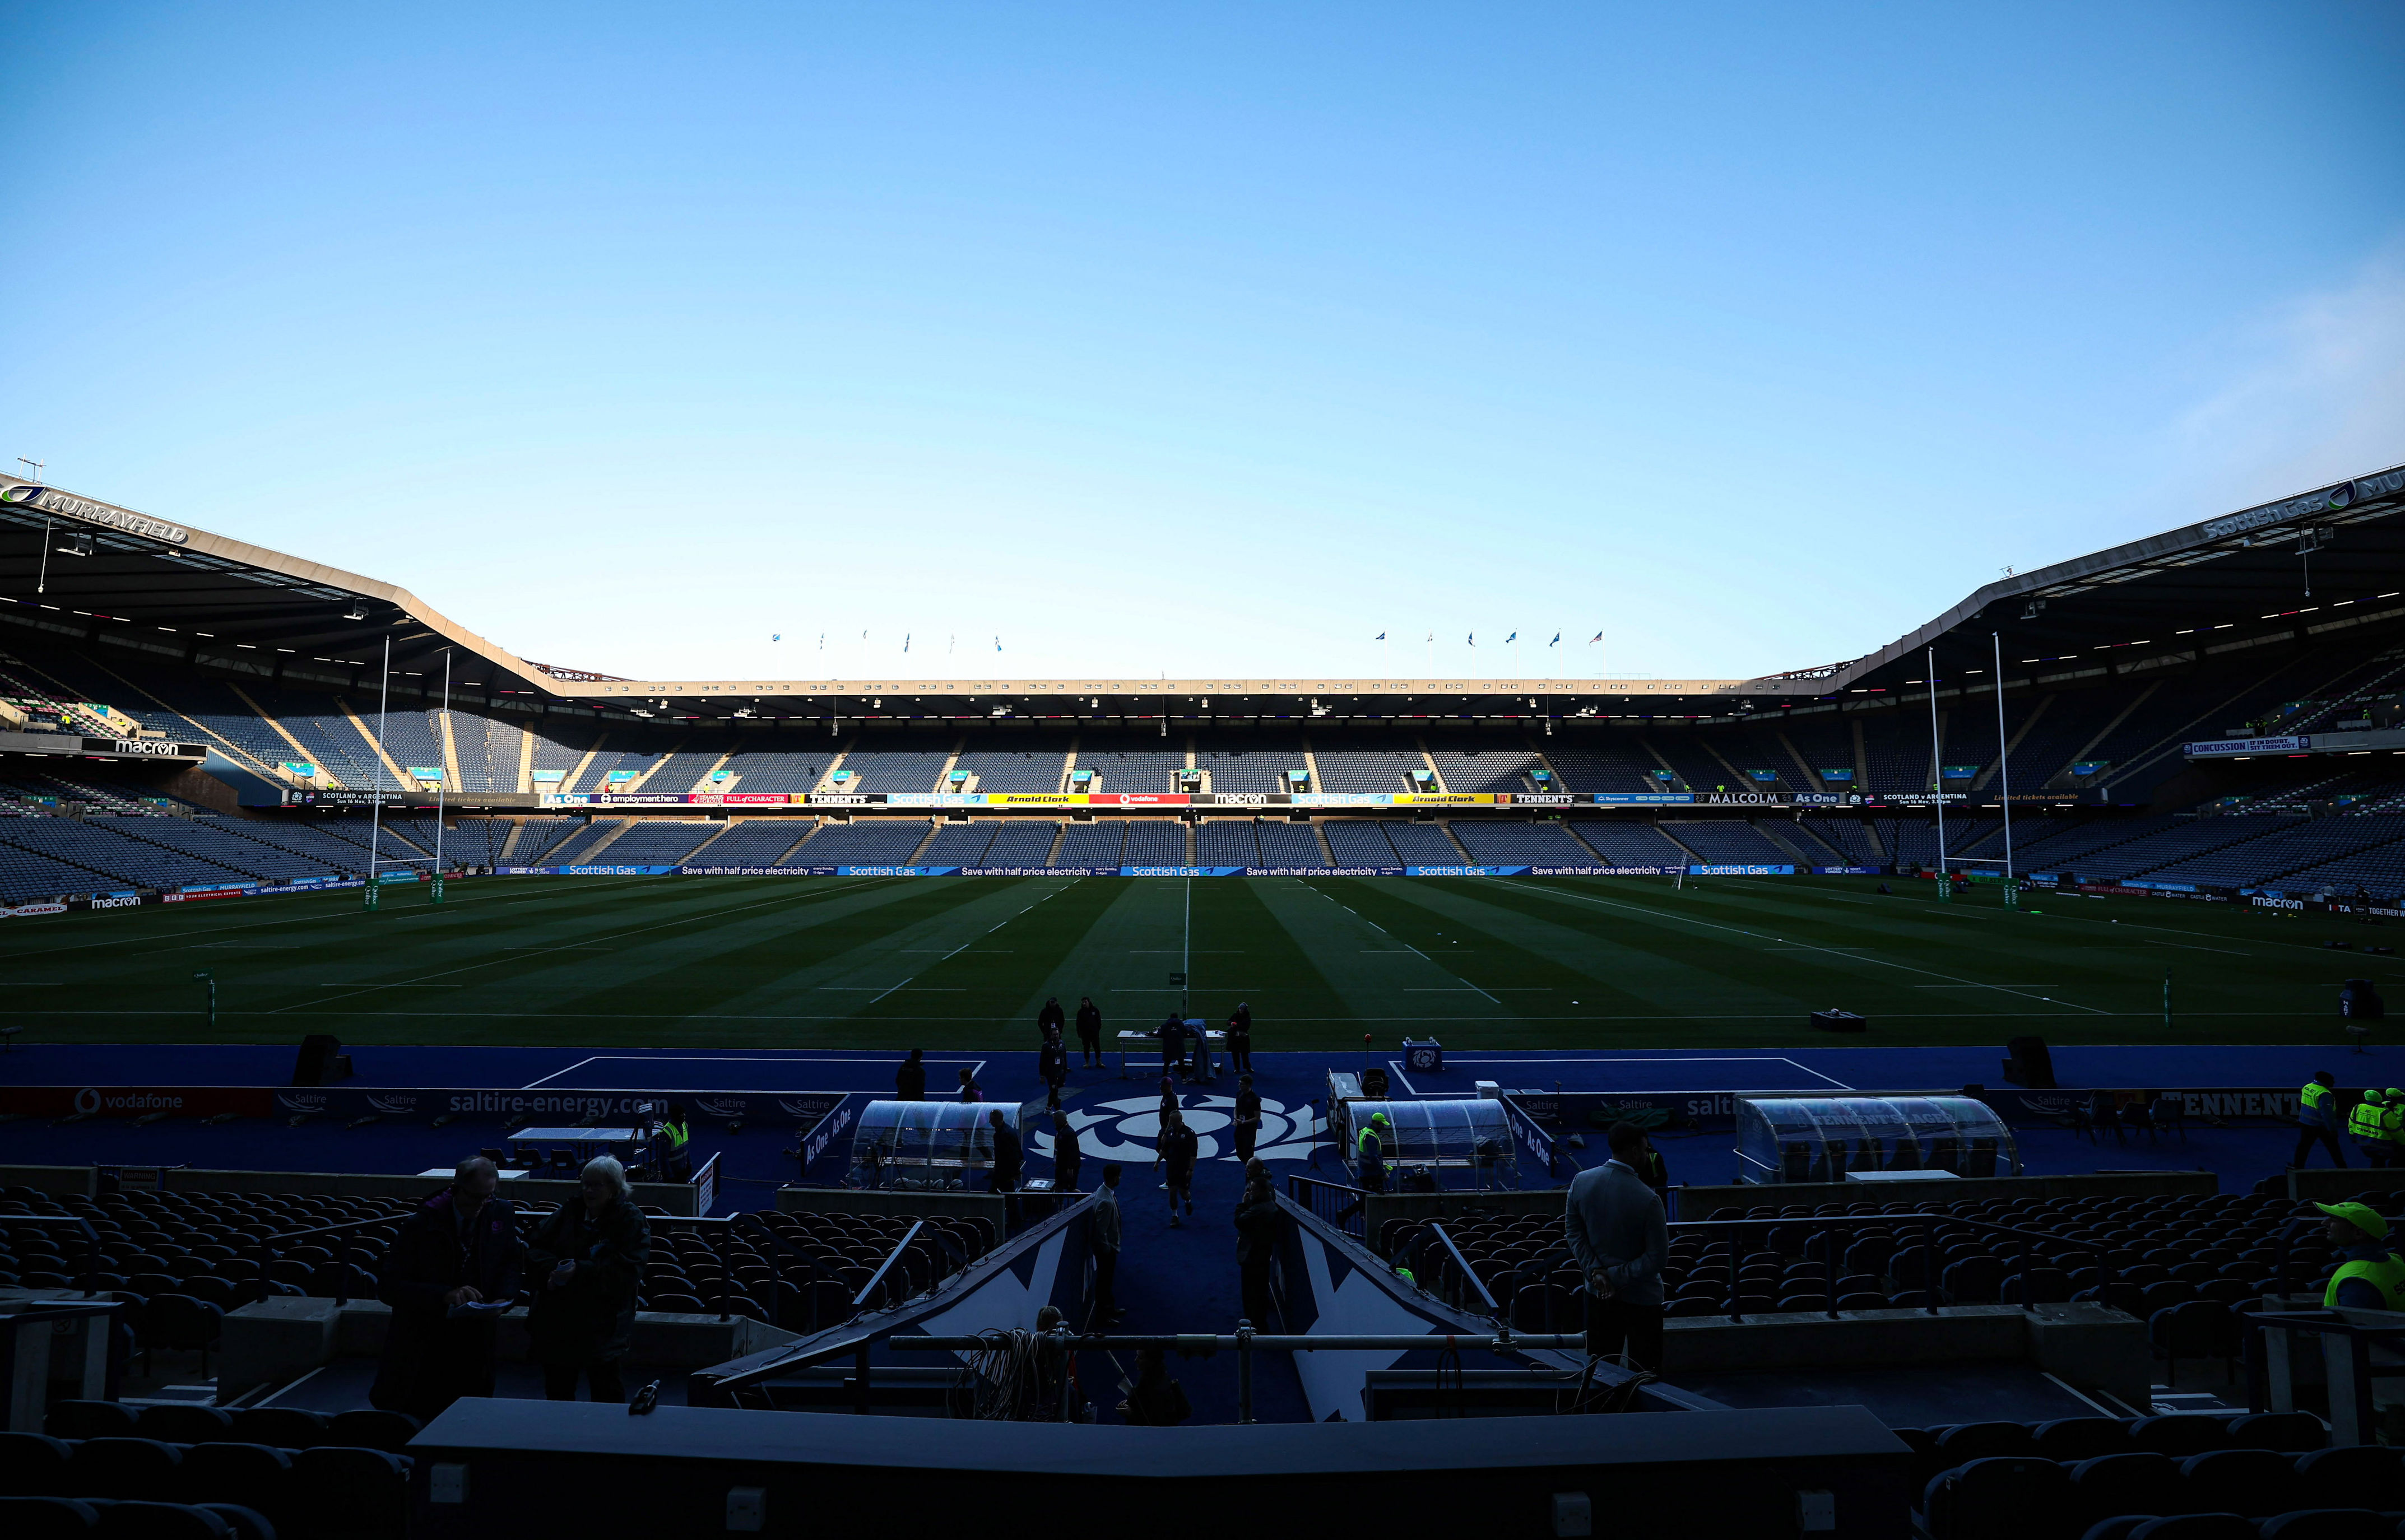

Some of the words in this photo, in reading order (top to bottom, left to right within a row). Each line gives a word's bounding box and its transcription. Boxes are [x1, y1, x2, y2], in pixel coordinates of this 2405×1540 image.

[40, 491, 187, 543] MURRAYFIELD
[2203, 508, 2280, 538] Scottish
[2282, 497, 2323, 518] Gas
[115, 740, 178, 756] macron
[2194, 742, 2245, 752] CONCUSSION
[546, 795, 562, 803] As
[564, 795, 588, 803] One
[893, 794, 941, 804] Scottish
[943, 794, 964, 804] Gas
[1215, 794, 1267, 804] macron
[1298, 794, 1346, 804] Scottish
[1348, 794, 1369, 804] Gas
[1709, 793, 1779, 803] MALCOLM
[1795, 794, 1811, 803] As
[1812, 794, 1838, 803] One
[570, 866, 614, 874] Scottish
[616, 866, 637, 874] Gas
[682, 866, 703, 874] Save
[704, 866, 723, 874] with
[725, 866, 741, 874] half
[742, 866, 763, 876] price
[765, 866, 809, 876] electricity
[849, 867, 893, 876] Scottish
[895, 867, 916, 876] Gas
[962, 867, 982, 876] Save
[985, 867, 1004, 876] with
[1005, 867, 1022, 876] half
[1023, 867, 1044, 877] price
[1047, 867, 1091, 877] electricity
[1132, 867, 1177, 876] Scottish
[1179, 867, 1199, 876] Gas
[1246, 867, 1268, 876] Save
[1269, 867, 1288, 876] with
[1290, 867, 1306, 876] half
[1308, 867, 1329, 877] price
[1332, 867, 1377, 877] electricity
[1418, 867, 1463, 876] Scottish
[1465, 867, 1485, 876] Gas
[1532, 866, 1553, 874] Save
[1554, 866, 1574, 874] with
[1575, 866, 1591, 874] half
[1593, 866, 1615, 876] price
[1617, 866, 1661, 876] electricity
[1701, 866, 1745, 874] Scottish
[1748, 866, 1768, 874] Gas
[261, 884, 308, 893] saltire-energy.com
[2156, 885, 2194, 894] MURRAYFIELD
[91, 896, 141, 909] macron
[2253, 896, 2304, 910] macron
[17, 906, 63, 914] CARAMEL
[2369, 908, 2398, 916] TOGETHER
[105, 1093, 183, 1109] vodafone
[295, 1094, 327, 1104] Saltire
[384, 1095, 416, 1104] Saltire
[713, 1098, 746, 1108] Saltire
[797, 1099, 829, 1109] Saltire
[2038, 1096, 2070, 1105] Saltire
[450, 1091, 668, 1118] saltire-energy.com
[1526, 1101, 1559, 1110] Saltire
[1619, 1100, 1652, 1109] Saltire
[833, 1119, 839, 1138] As
[840, 1109, 851, 1129] One
[1814, 1114, 1903, 1126] TENNENT'S
[1511, 1113, 1522, 1138] One
[1527, 1129, 1535, 1152] As
[1536, 1138, 1549, 1166] One
[807, 1144, 815, 1165] As
[816, 1132, 828, 1155] One
